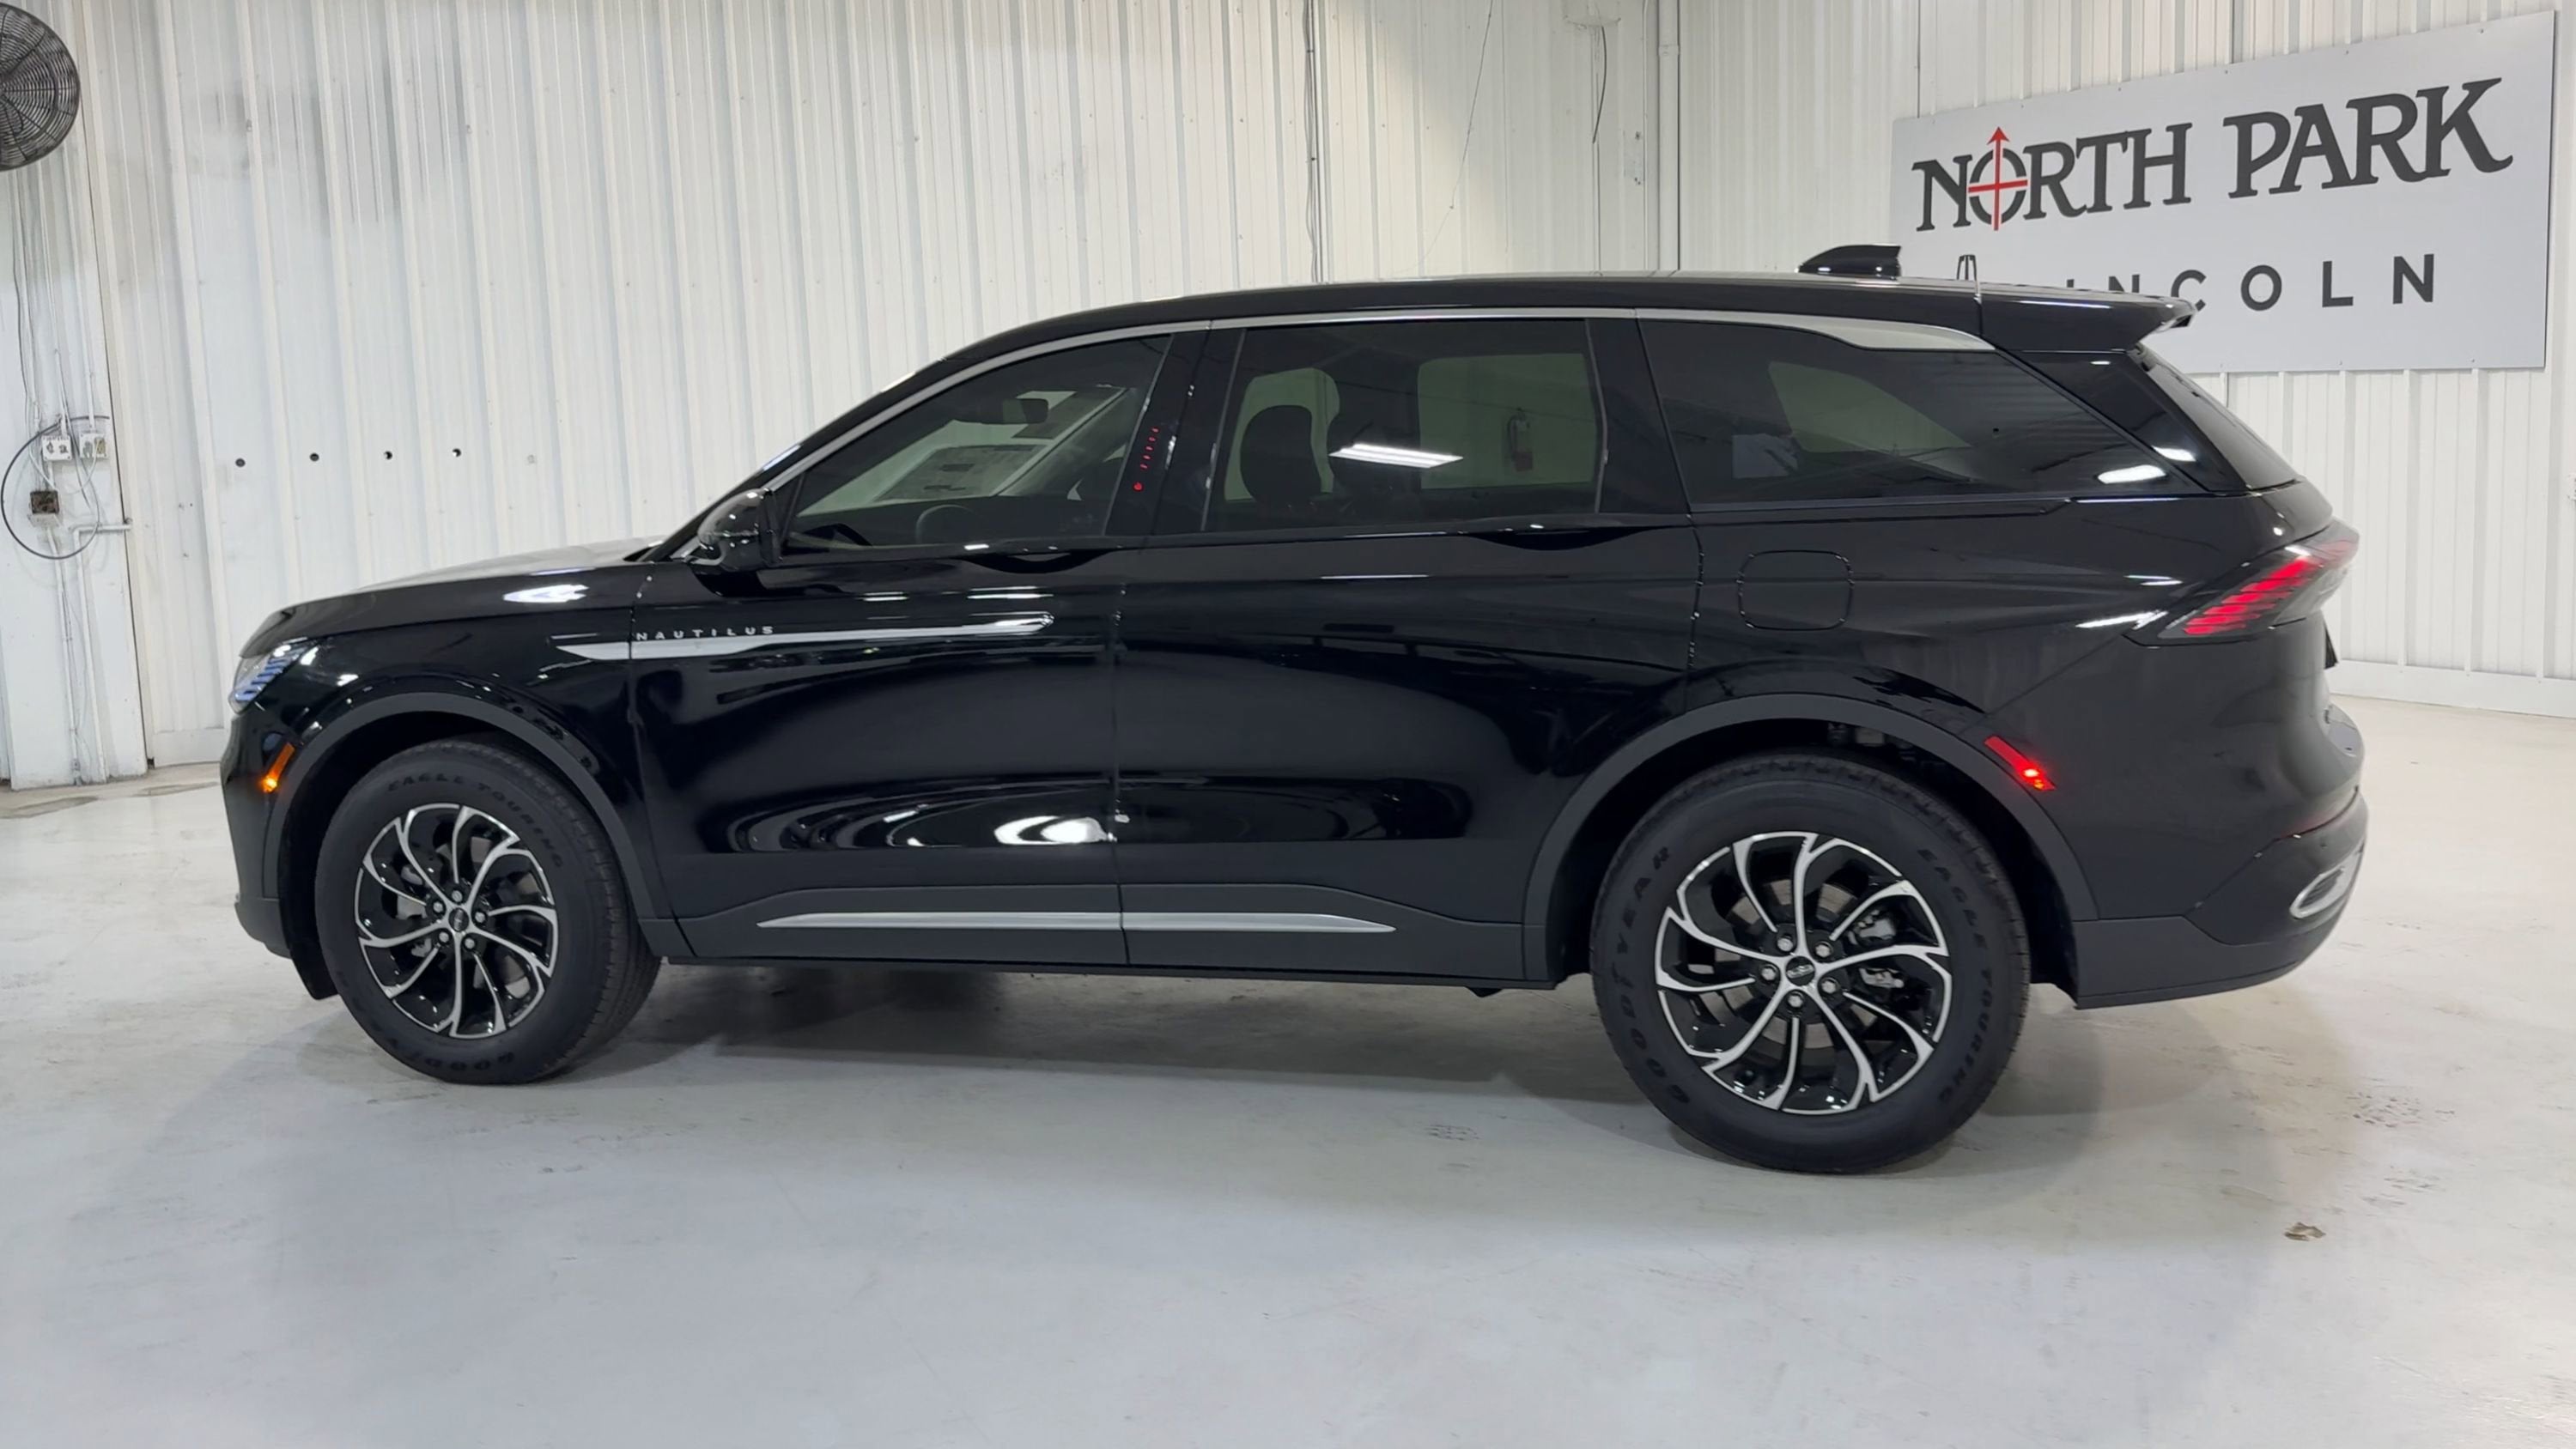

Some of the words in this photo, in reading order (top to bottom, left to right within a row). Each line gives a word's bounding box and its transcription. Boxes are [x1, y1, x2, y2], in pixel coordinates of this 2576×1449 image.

[1911, 122, 2193, 233] NORTH
[2223, 77, 2514, 199] PARK
[635, 626, 774, 641] NAUTILUS
